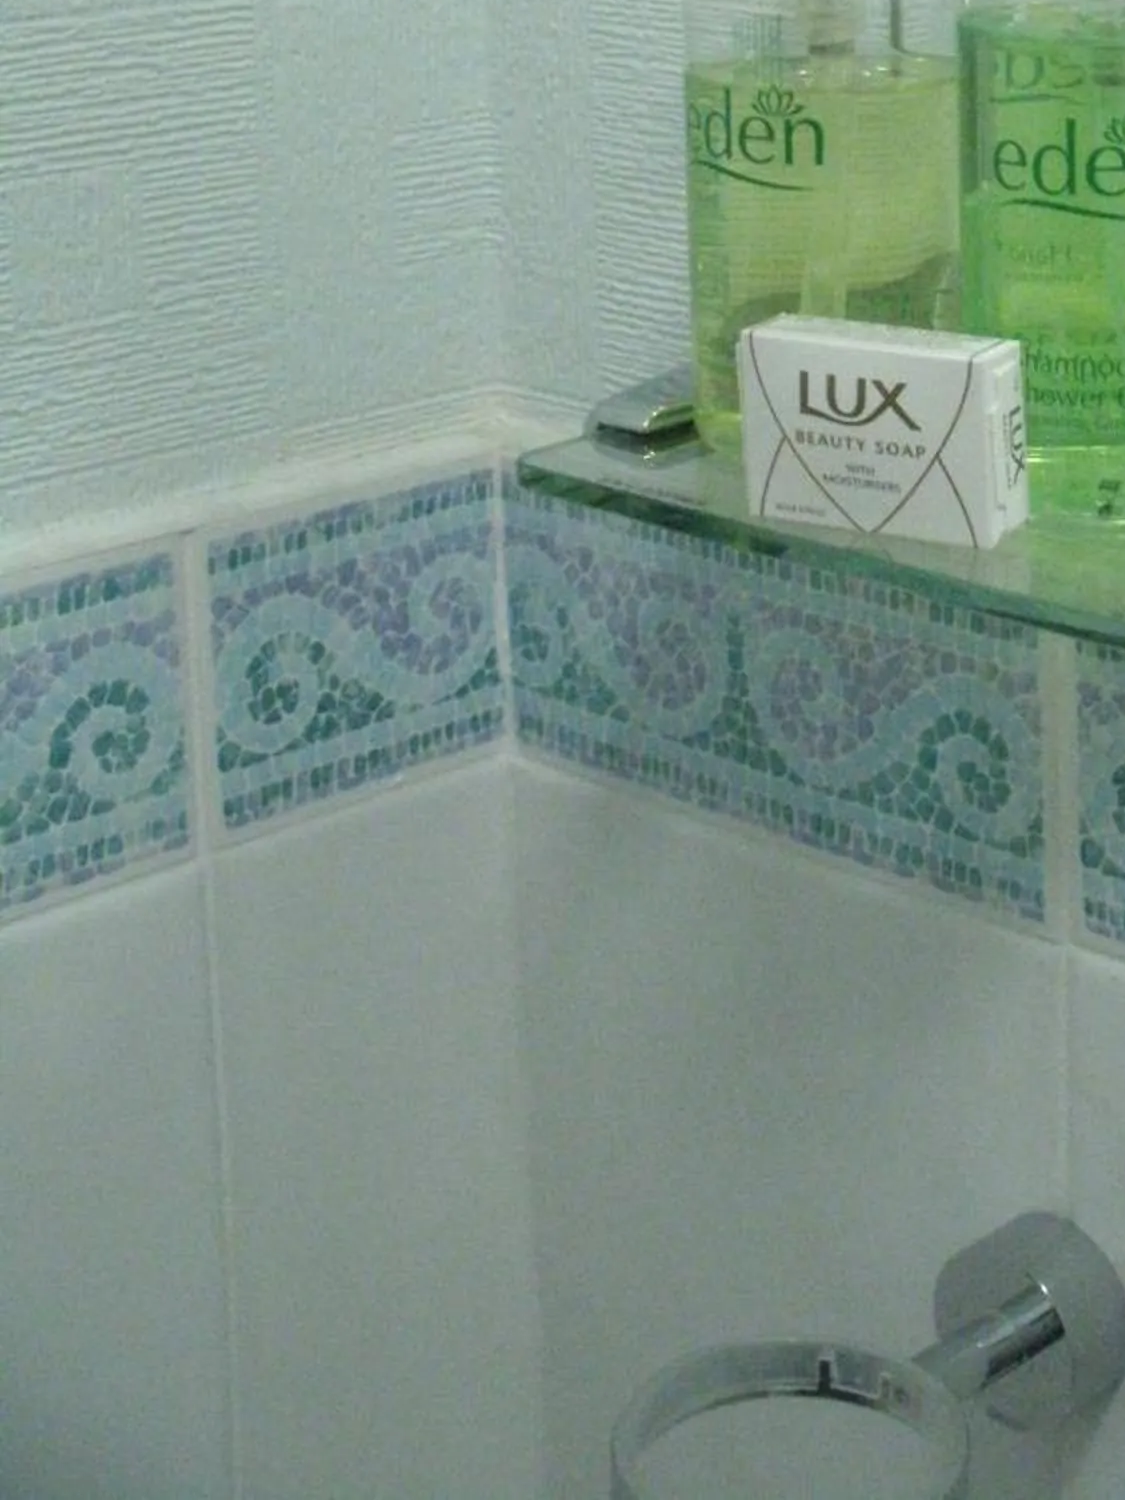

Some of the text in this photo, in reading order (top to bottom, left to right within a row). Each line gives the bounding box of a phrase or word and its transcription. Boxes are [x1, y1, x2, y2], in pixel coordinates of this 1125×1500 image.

[686, 85, 825, 167] eden
[798, 369, 922, 433] LUX
[1024, 377, 1109, 408] hower
[795, 429, 927, 460] BEAUTY SOAP
